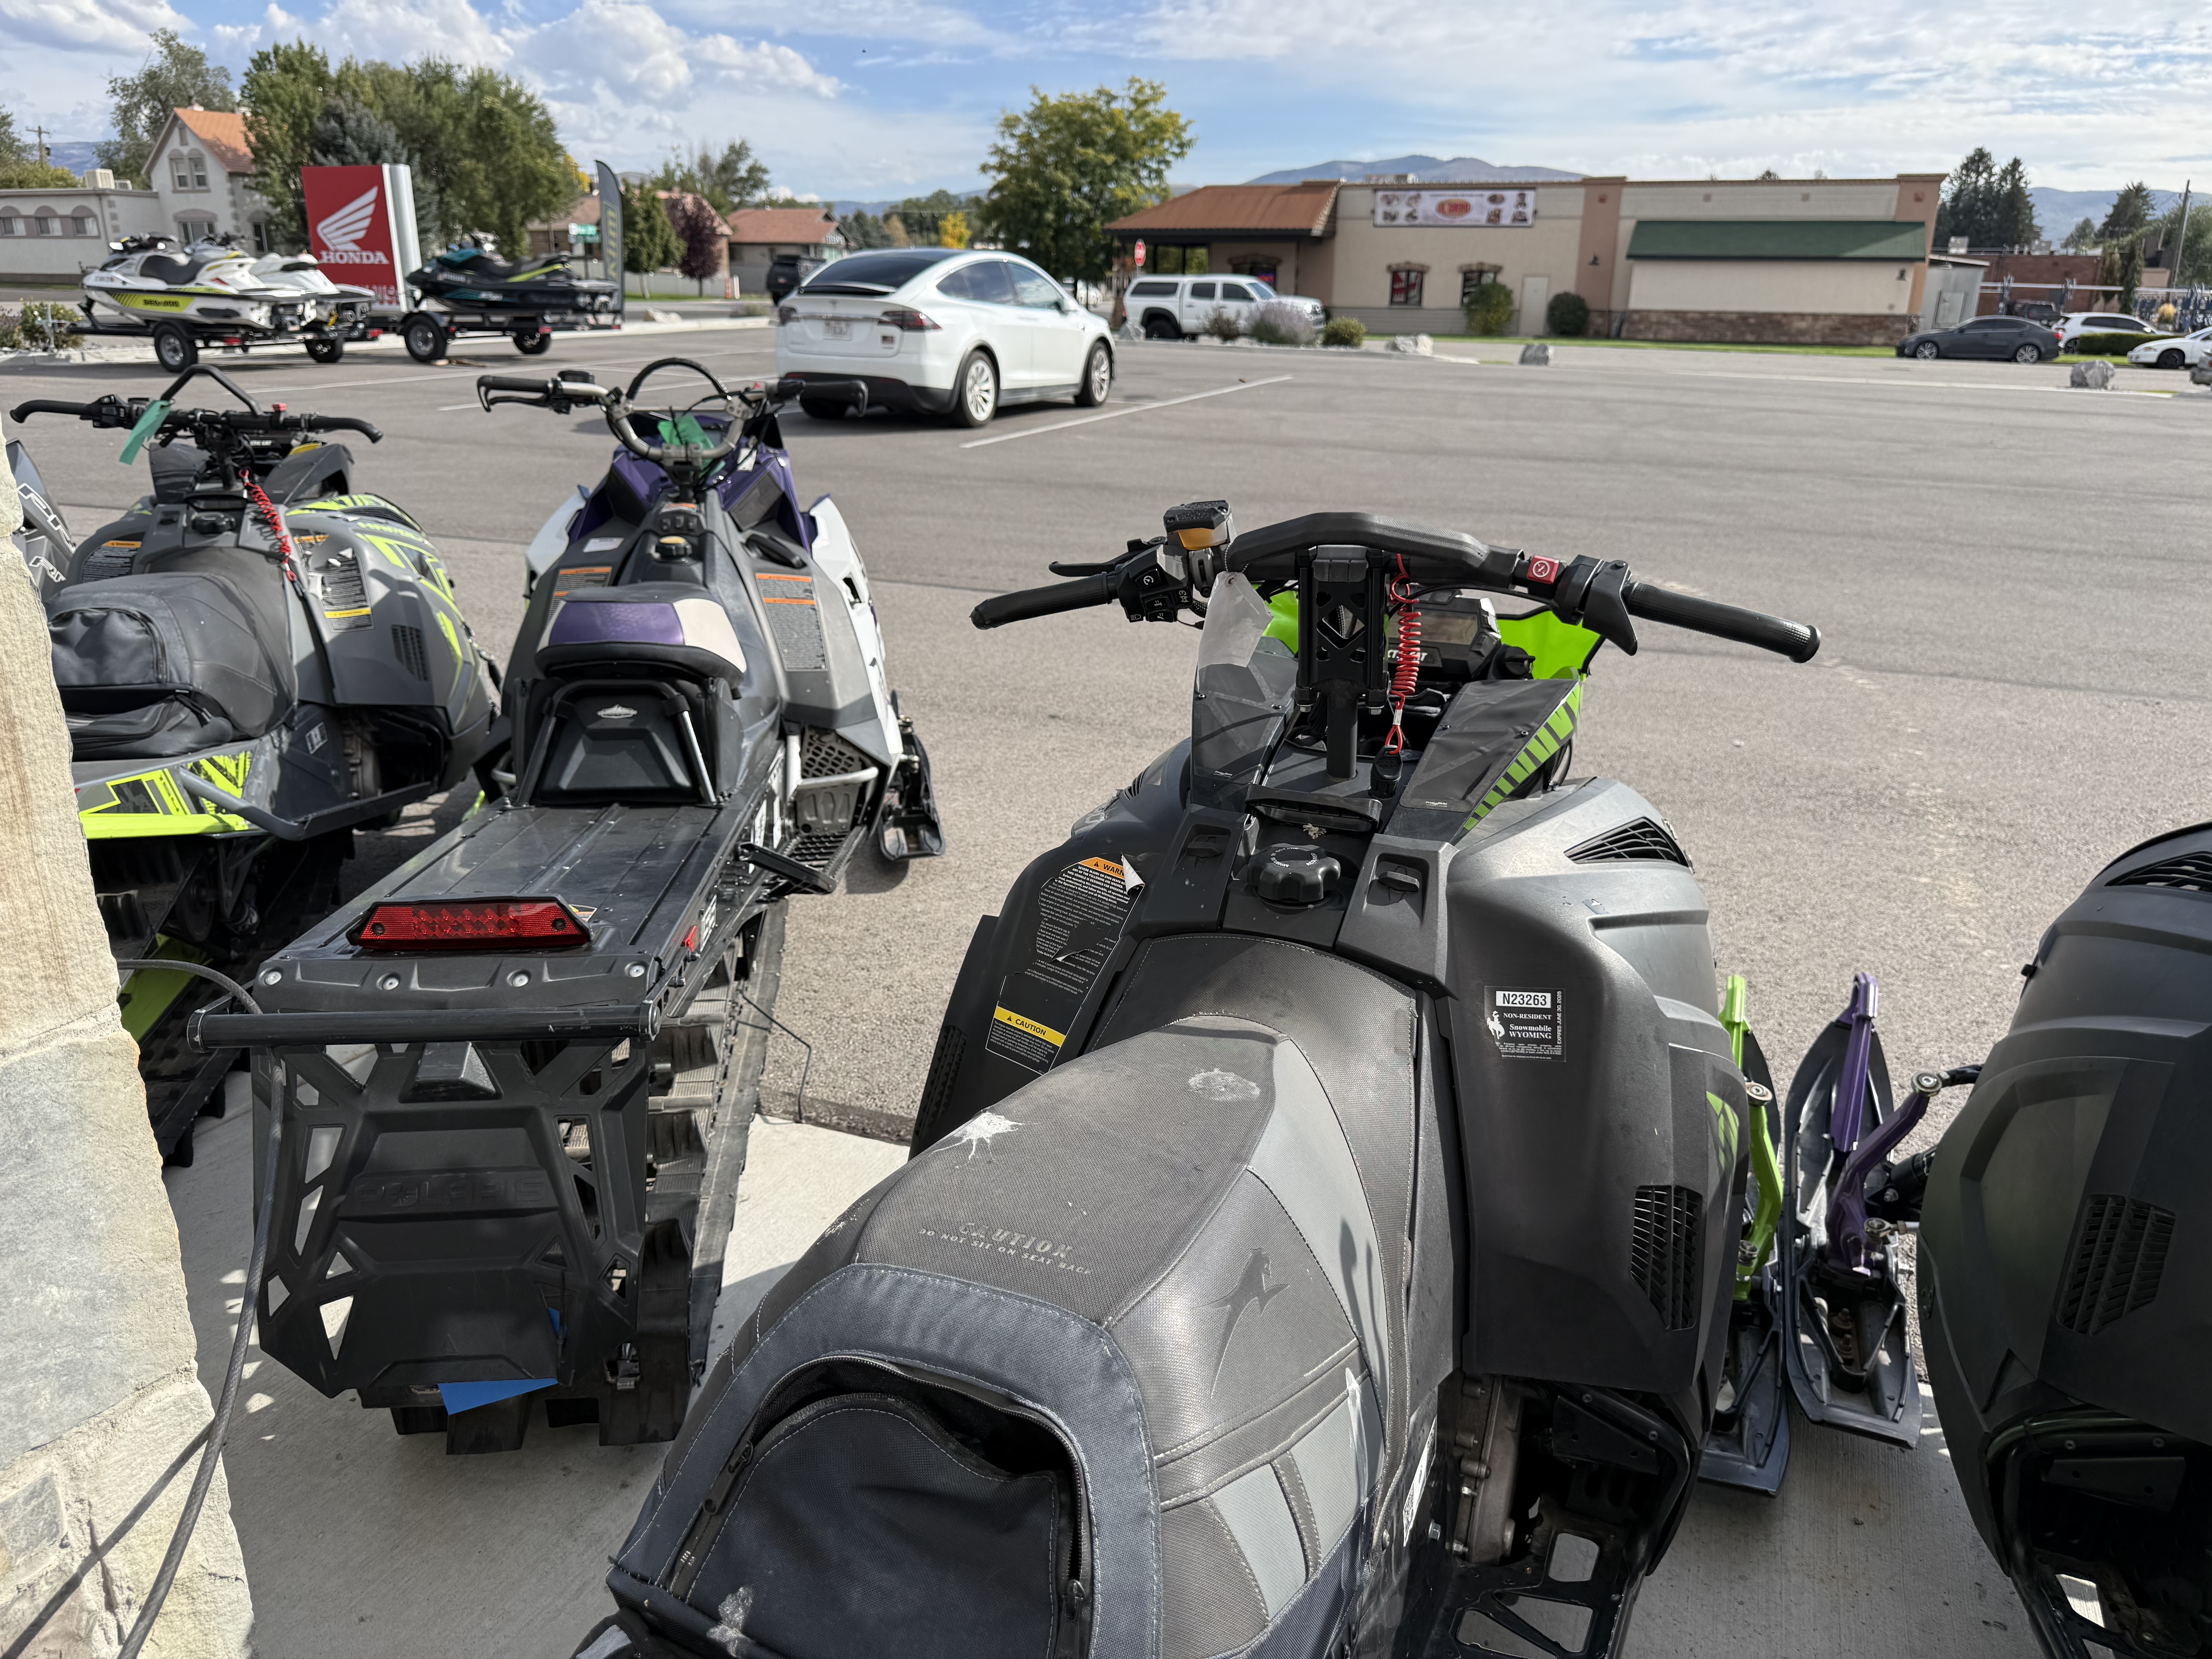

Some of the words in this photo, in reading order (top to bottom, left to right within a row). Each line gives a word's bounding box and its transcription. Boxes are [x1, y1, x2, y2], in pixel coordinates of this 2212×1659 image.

[318, 251, 390, 264] HONDA
[1103, 863, 1124, 876] WARN
[1503, 993, 1547, 1006] N23263
[1015, 1018, 1046, 1036] CAUTION
[1510, 1024, 1552, 1032] Snowmobile
[1509, 1031, 1551, 1039] WYOMING
[352, 1176, 544, 1207] POLARIS
[940, 1233, 967, 1243] NOT
[971, 1240, 994, 1250] SIT
[998, 1246, 1017, 1255] ON
[1021, 1252, 1053, 1265] SEAT
